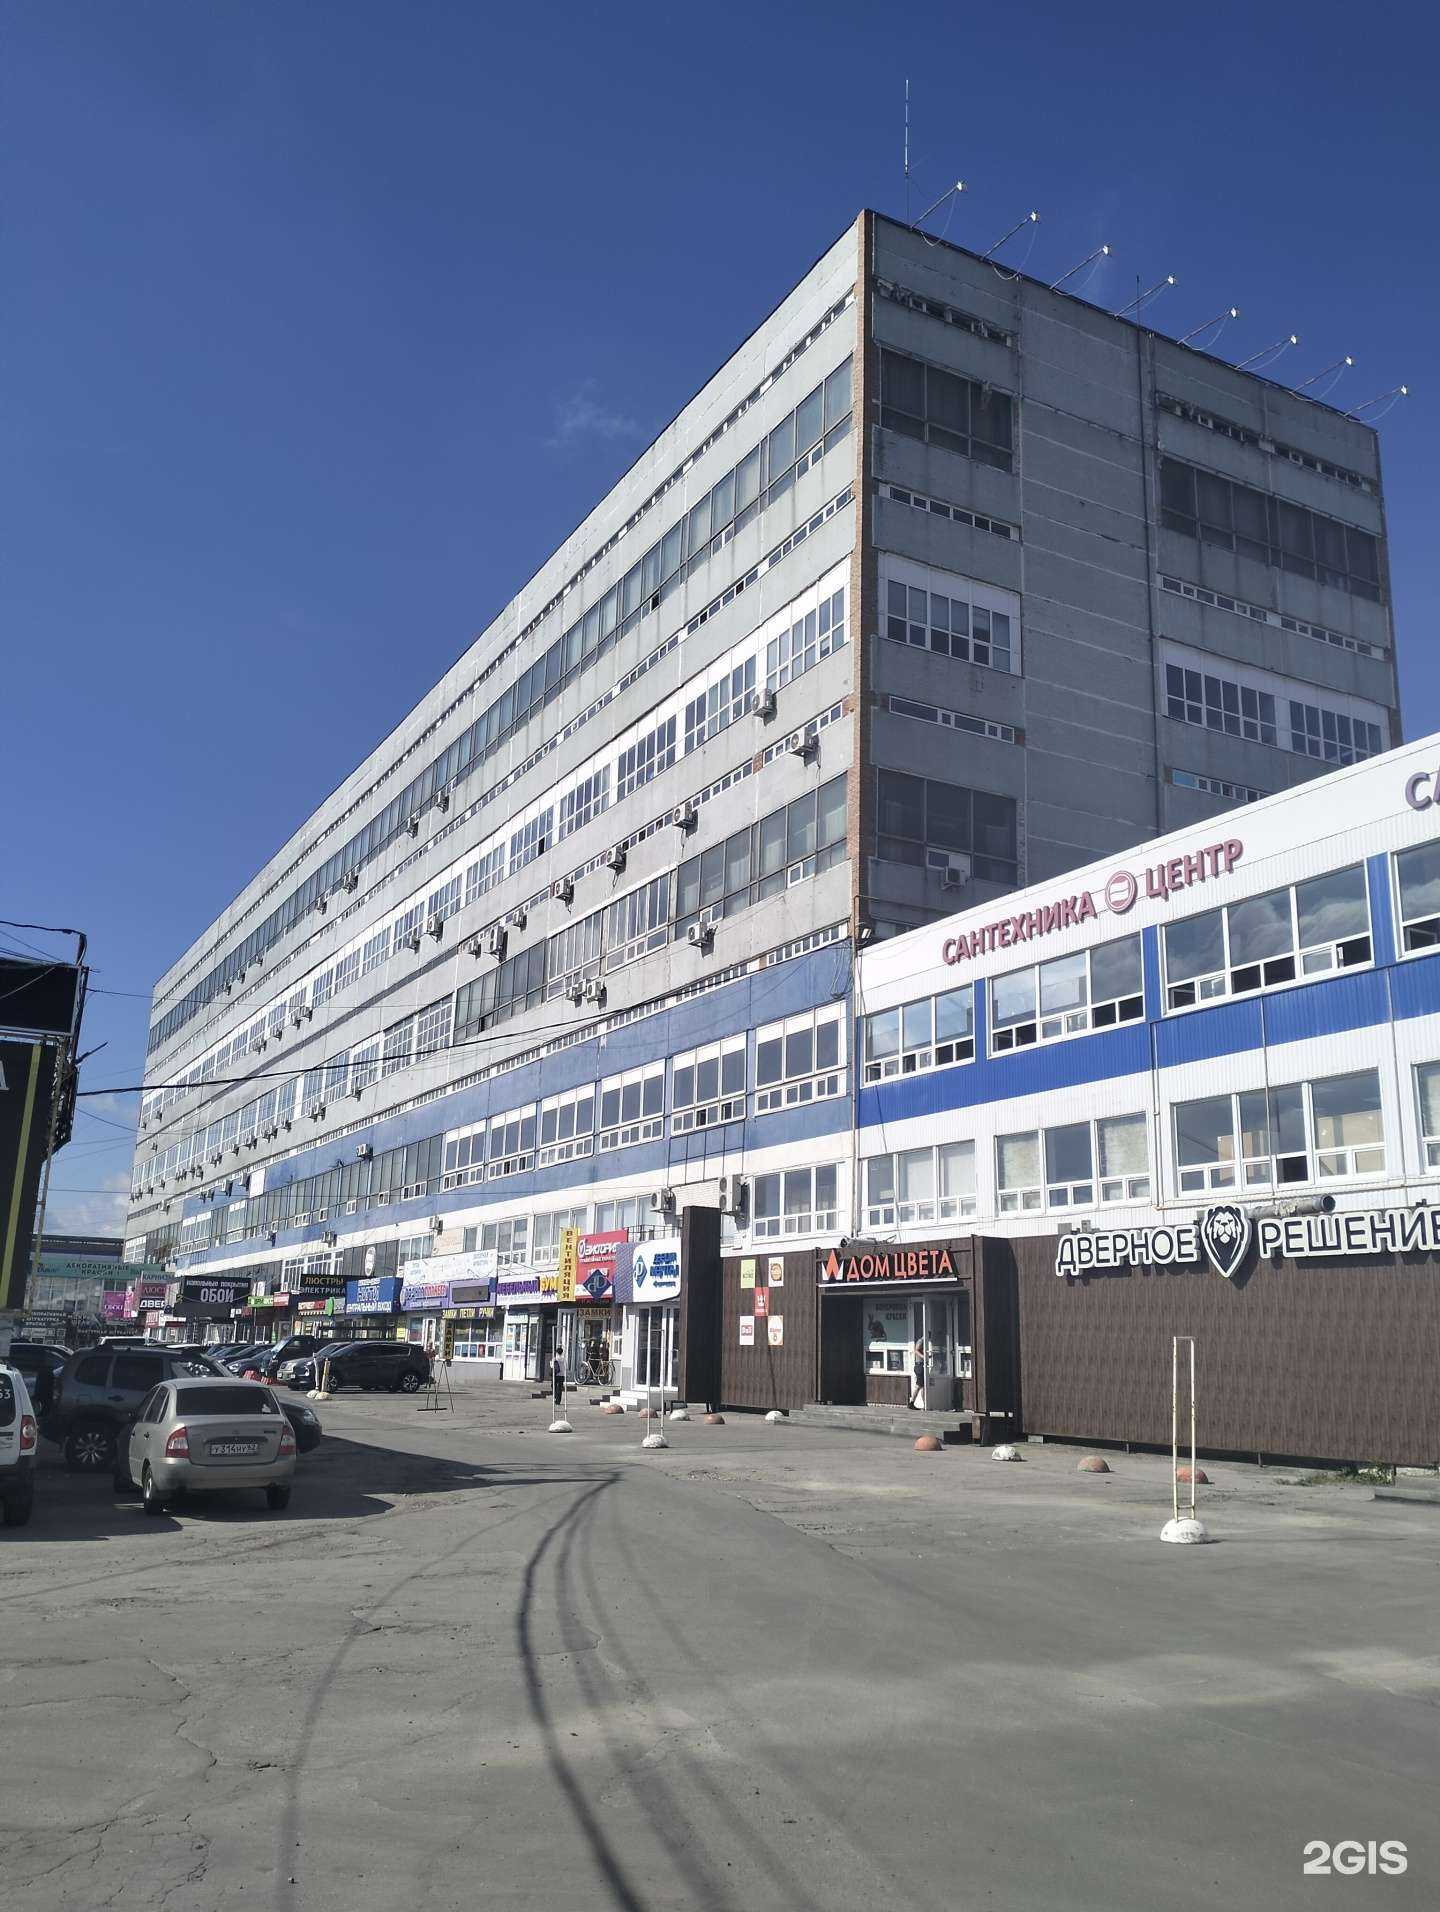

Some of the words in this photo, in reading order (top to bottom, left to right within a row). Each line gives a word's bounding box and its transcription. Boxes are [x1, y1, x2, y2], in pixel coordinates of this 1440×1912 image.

[1405, 768, 1440, 811] С
[942, 890, 1097, 965] САНТЕХНИКА
[1145, 838, 1244, 900] ЦЕНТР
[562, 1230, 573, 1299] ВЕНТИЛЯЦИЯ
[847, 1254, 890, 1281] ДОМ
[894, 1250, 953, 1278] ЦВЕТА
[1057, 1226, 1197, 1274] ДВЕРНОЕ
[201, 1288, 235, 1303] ОБОИ
[300, 1286, 346, 1295] ЭЛЕКТРИКА
[304, 1276, 344, 1285] ЛЮСТРЫ
